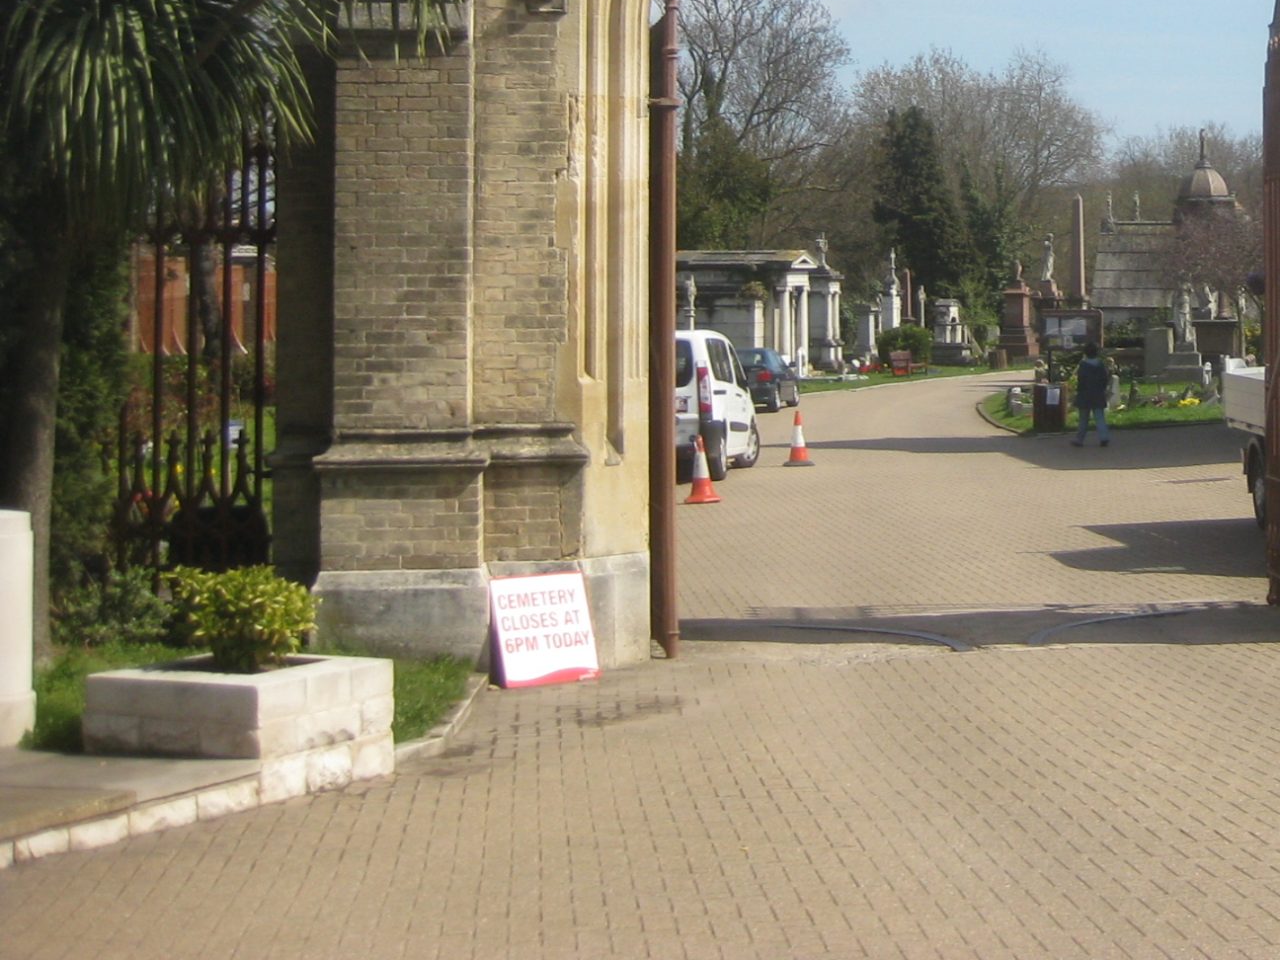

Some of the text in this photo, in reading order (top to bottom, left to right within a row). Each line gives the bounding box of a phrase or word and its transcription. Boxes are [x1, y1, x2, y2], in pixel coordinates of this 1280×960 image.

[497, 589, 576, 610] CEMETERY
[501, 609, 580, 632] CLOSES AT
[505, 630, 590, 654] 6PM TODAY
